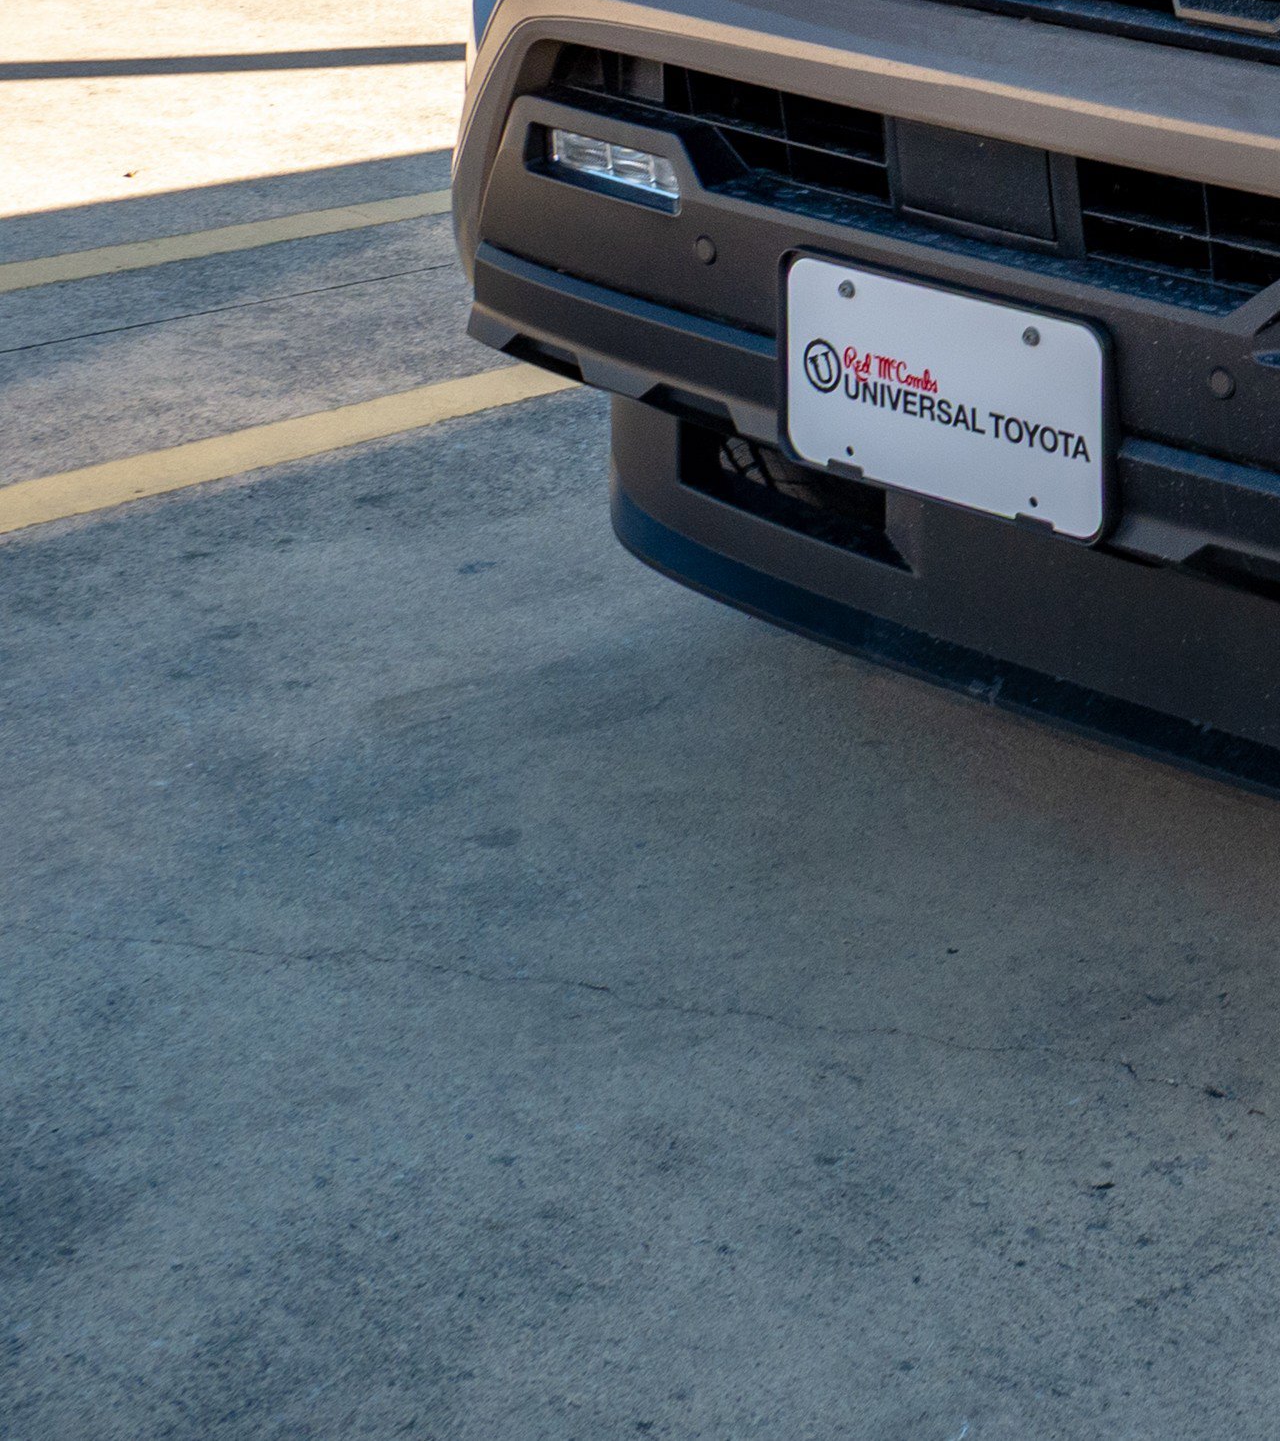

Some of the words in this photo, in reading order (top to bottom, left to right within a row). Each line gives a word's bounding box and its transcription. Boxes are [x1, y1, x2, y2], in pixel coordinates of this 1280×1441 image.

[844, 346, 871, 382] Red
[844, 373, 986, 435] UNIVERSAL
[989, 412, 1091, 462] TOYOTA
